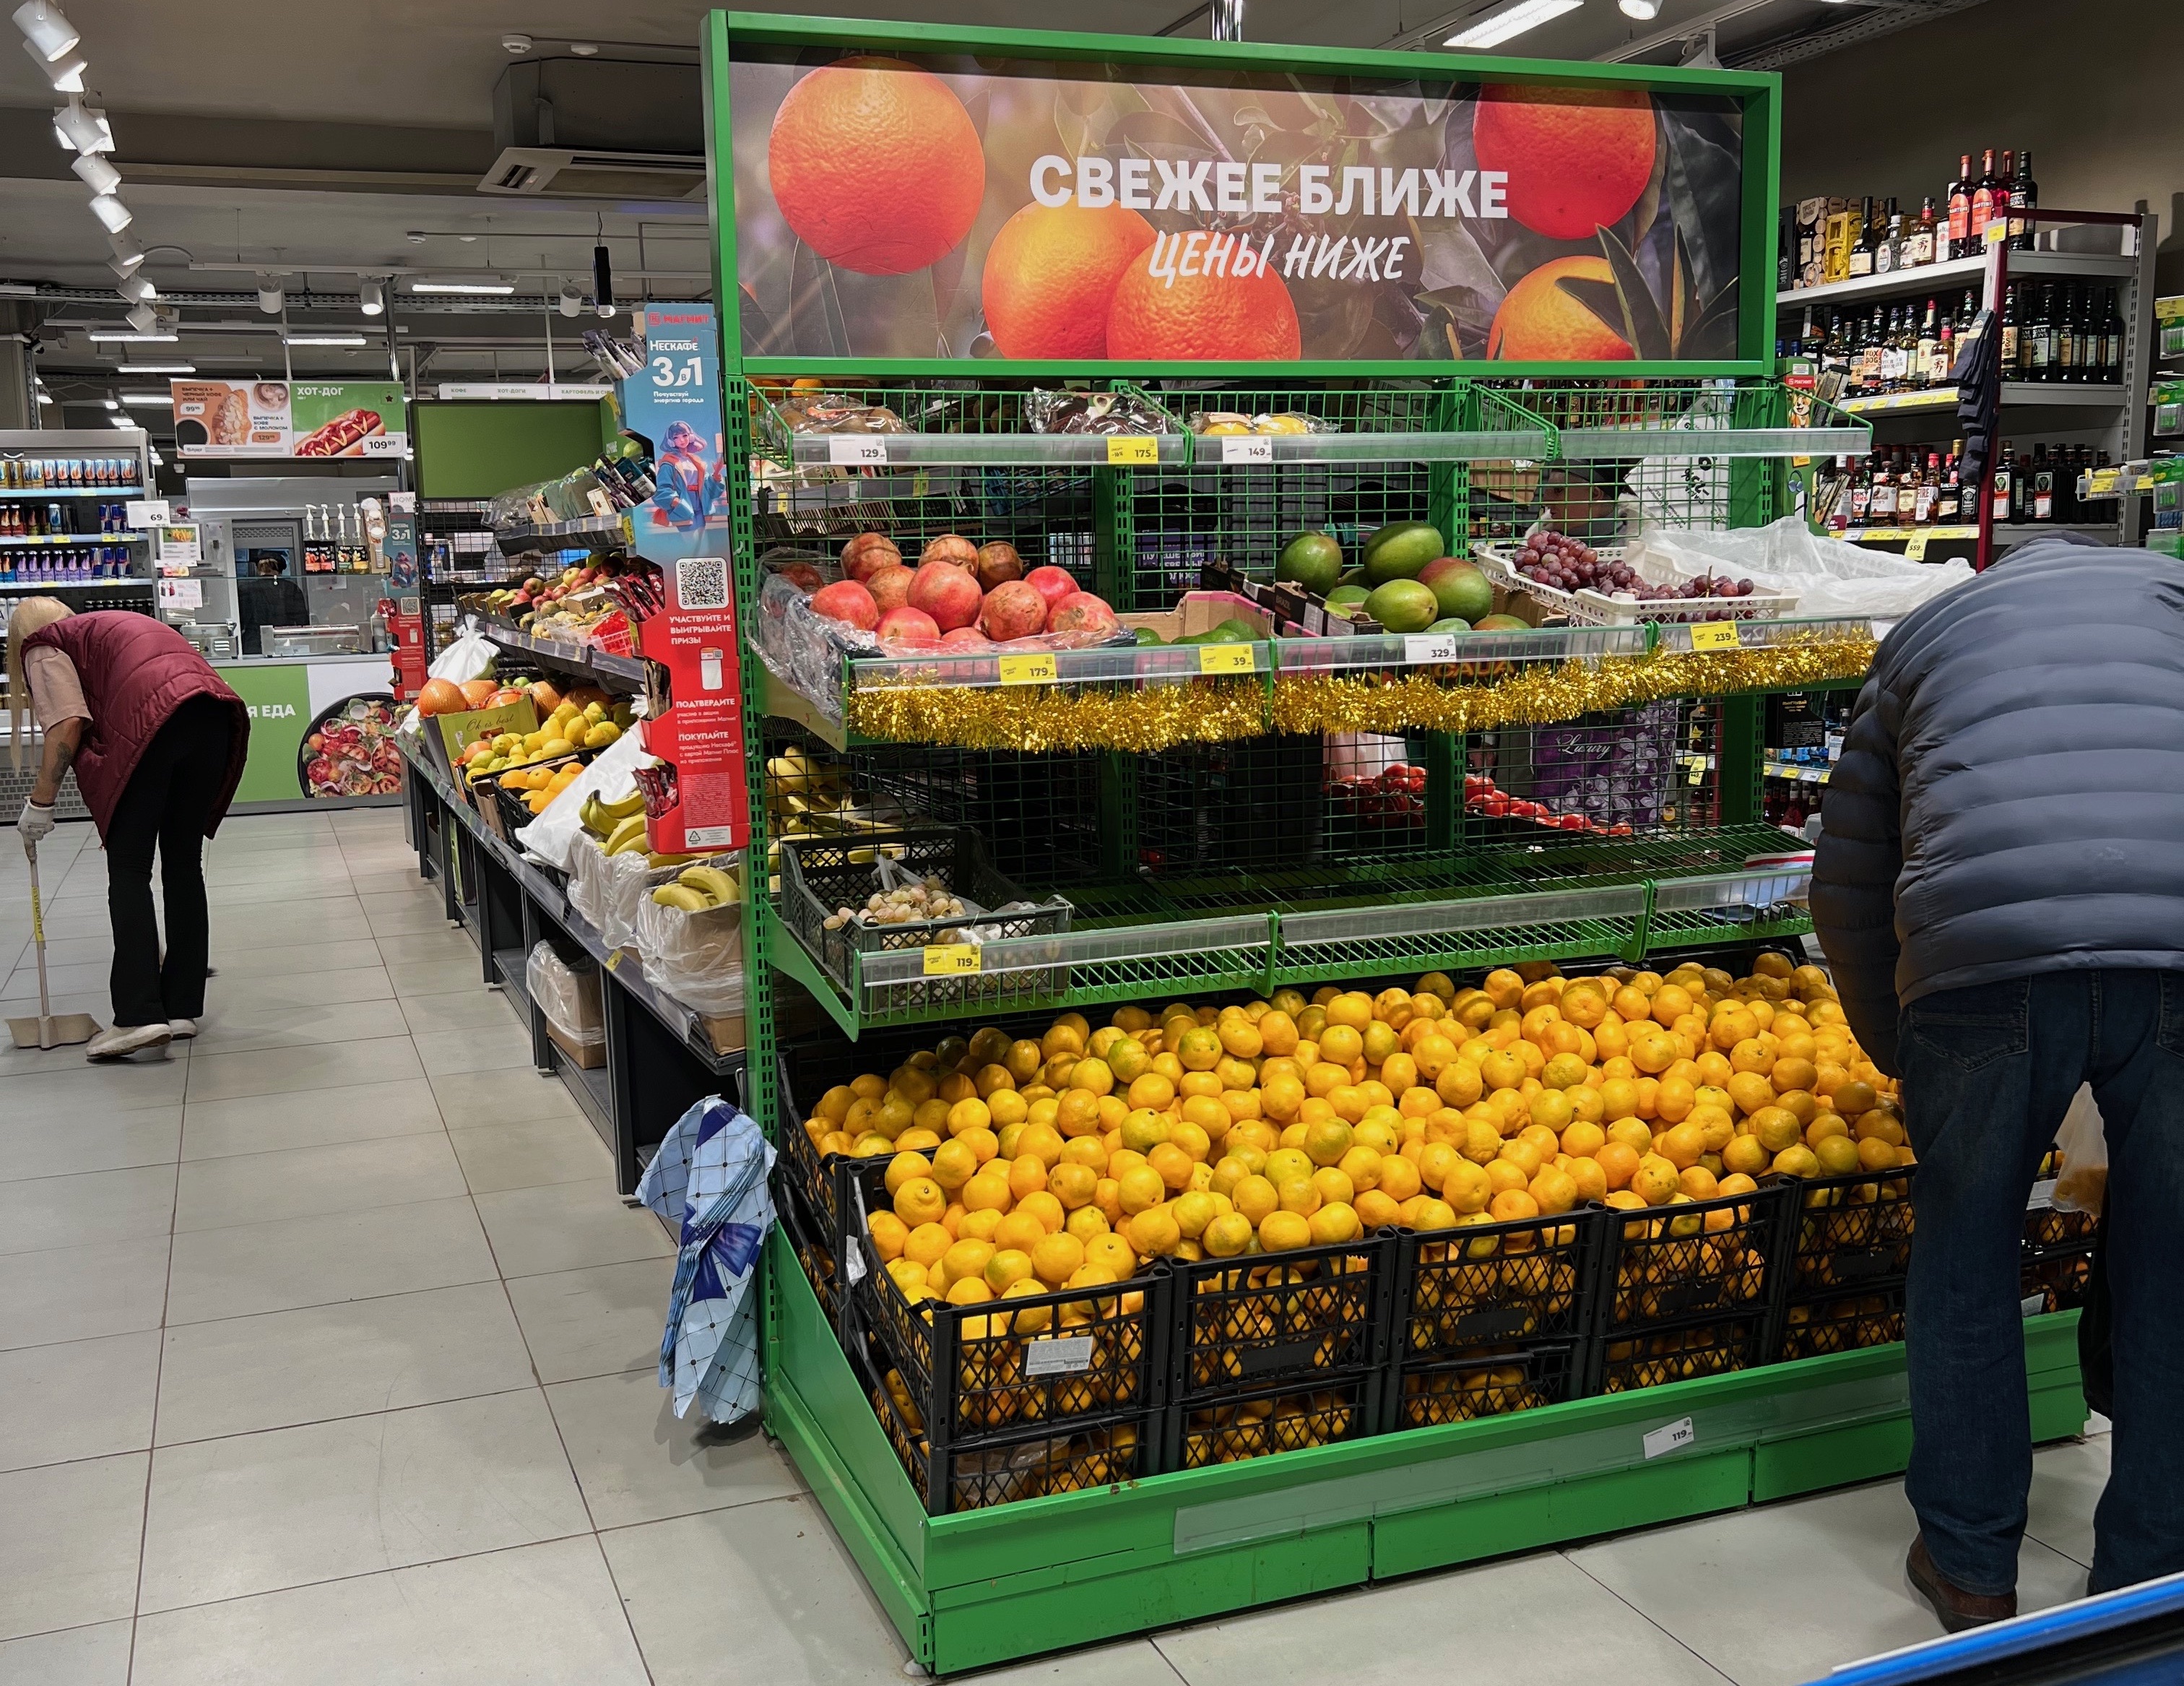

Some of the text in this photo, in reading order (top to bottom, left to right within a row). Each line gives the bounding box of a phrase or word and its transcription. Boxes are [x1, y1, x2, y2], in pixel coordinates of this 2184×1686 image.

[1029, 155, 1509, 219] СВЕЖЕЕ БЛИЖЕ
[1148, 230, 1410, 288] ЦЕНЫ НИЖЕ
[663, 314, 709, 324] МАГНИТ
[297, 387, 344, 397] ХОТ-ДОГ
[861, 449, 879, 458] 129
[1249, 447, 1265, 456] 149
[670, 613, 722, 623] УЧАСТВУЙТЕ
[670, 623, 732, 634] ВЫИГРЫВАЙТЕ
[1715, 633, 1731, 641] 239
[1431, 649, 1450, 657] 329
[1233, 657, 1246, 665] 39
[1030, 667, 1048, 677] 179
[676, 699, 735, 708] ПОДТВЕРДИТЕ
[261, 704, 296, 719] ЕДА
[678, 730, 729, 741] ПОКУПАЙТЕ
[1556, 734, 1611, 759] Luxury
[956, 958, 973, 967] 119
[1672, 1430, 1687, 1441] 119
